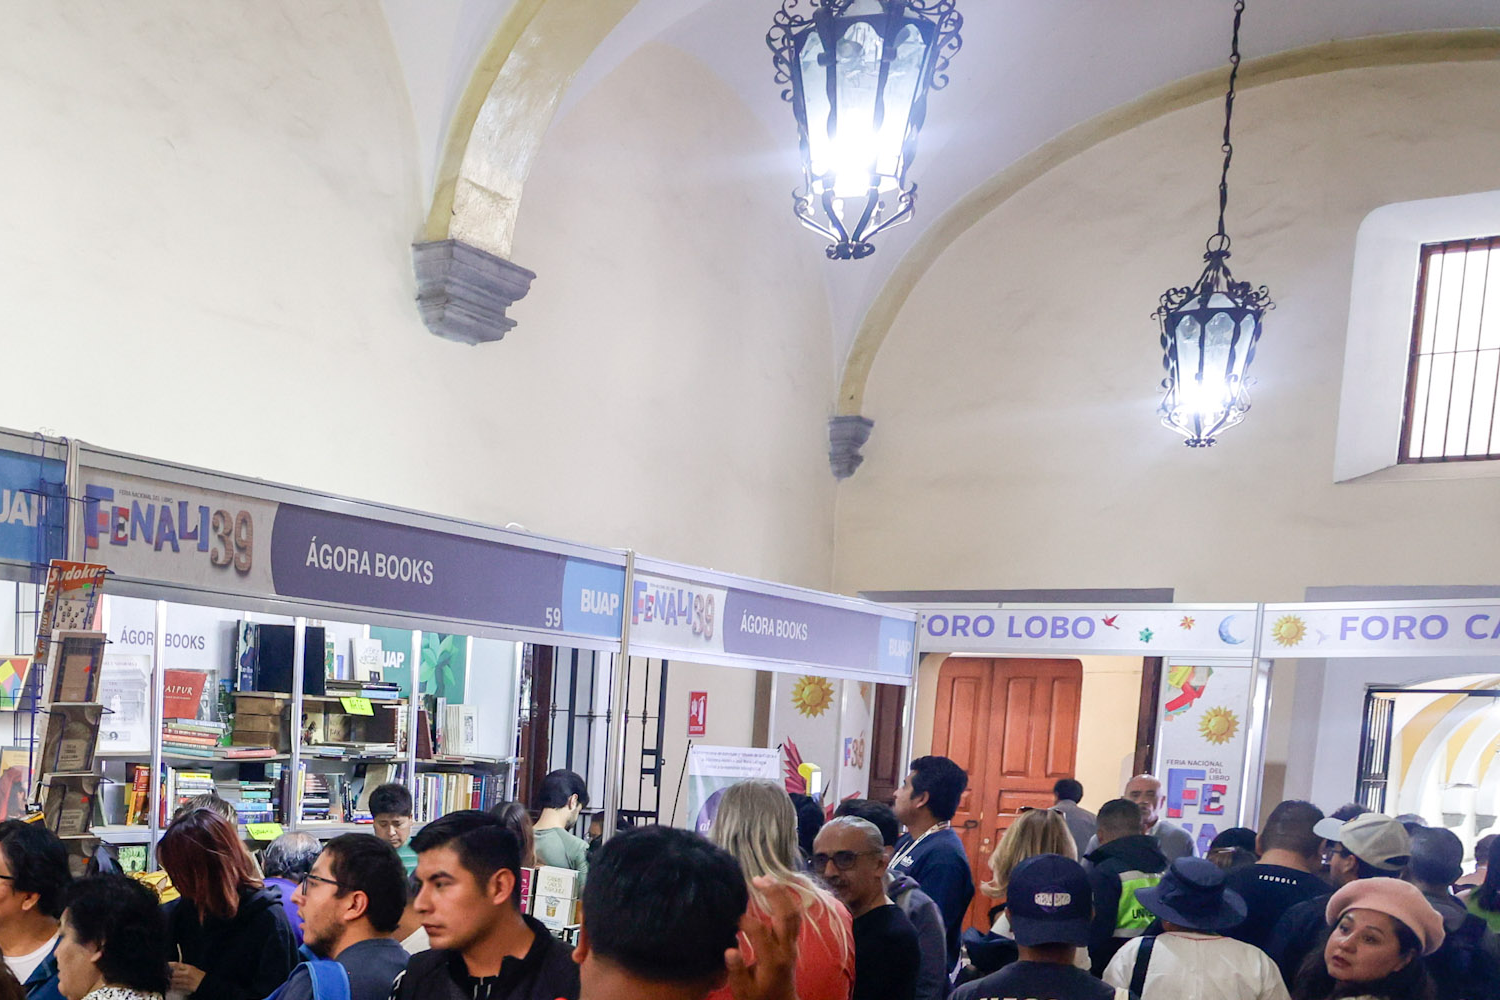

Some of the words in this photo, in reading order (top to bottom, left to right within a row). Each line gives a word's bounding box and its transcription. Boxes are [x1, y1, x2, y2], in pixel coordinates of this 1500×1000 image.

[306, 536, 371, 575] ÁGORA
[375, 553, 434, 585] BOOKS
[580, 588, 620, 617] BUAP
[545, 607, 561, 628] 59
[740, 608, 775, 637] ÁGORA
[776, 619, 808, 641] BOOKS
[922, 614, 995, 638] ORO
[1007, 615, 1096, 639] LOBO
[1339, 614, 1449, 641] FORO
[120, 626, 154, 646] ÁGOR
[164, 633, 205, 650] BOOKS
[381, 650, 405, 668] UAP
[164, 685, 193, 696] AIPUR
[1187, 759, 1223, 768] NACIONAL
[1208, 774, 1230, 782] LIBRO
